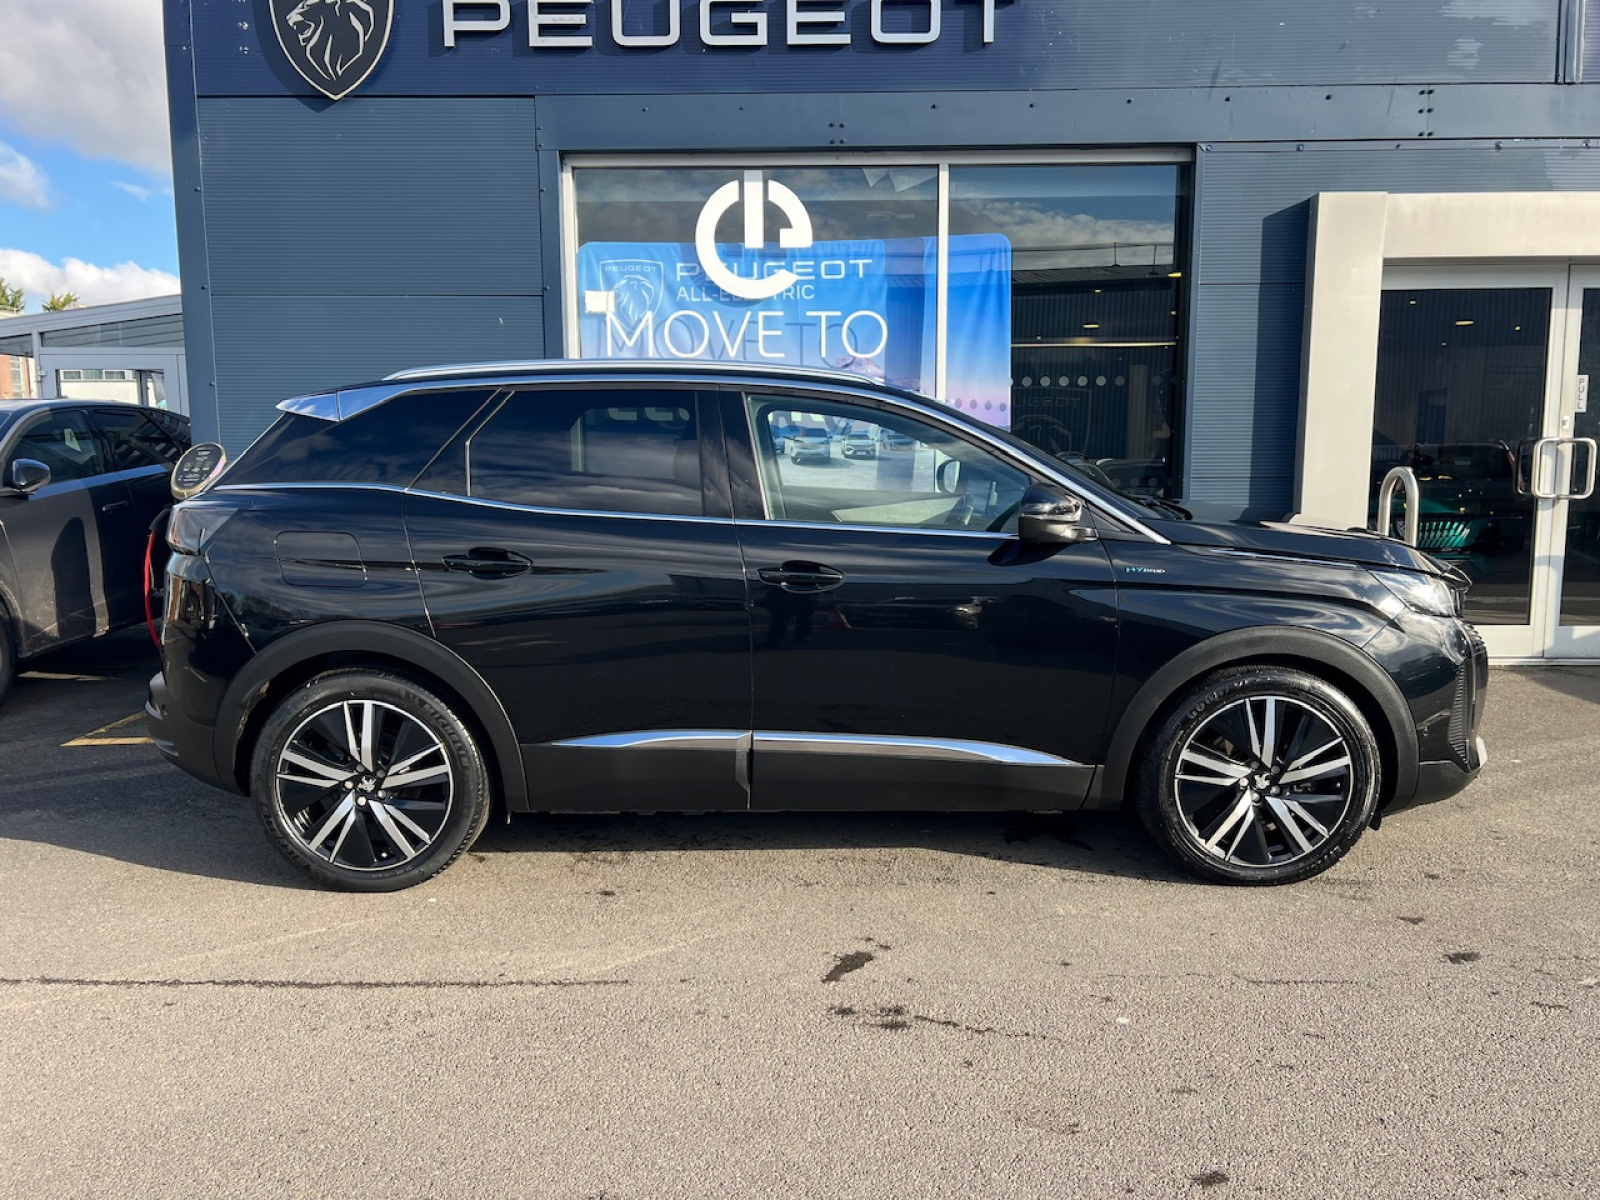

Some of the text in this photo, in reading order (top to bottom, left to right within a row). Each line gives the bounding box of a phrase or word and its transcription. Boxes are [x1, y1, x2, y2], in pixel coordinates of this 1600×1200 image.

[605, 264, 658, 273] PEUGEOT
[676, 260, 872, 281] PUGEOT
[676, 284, 815, 301] ALL-ERIC
[605, 309, 888, 359] MOVE TO
[1577, 377, 1585, 410] PULL
